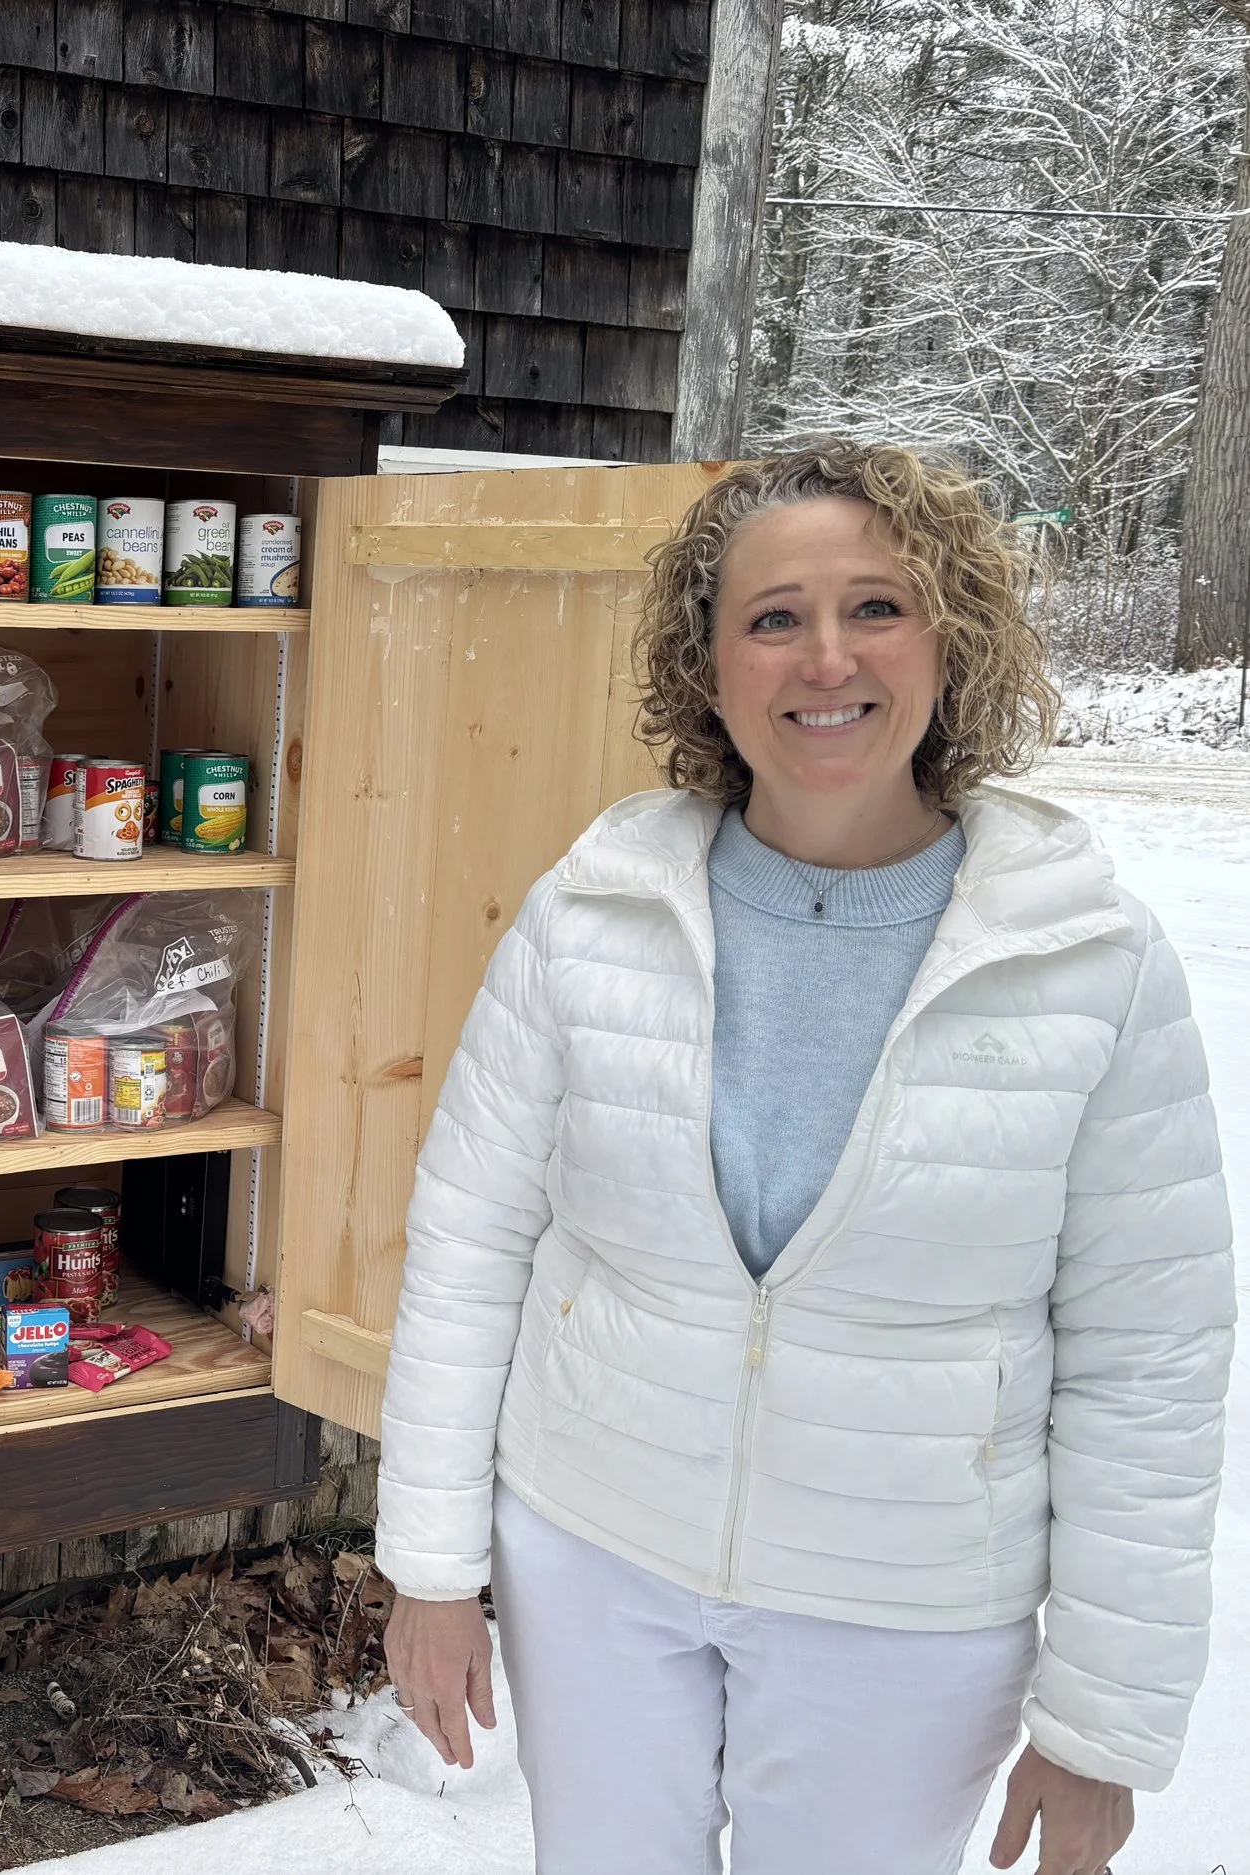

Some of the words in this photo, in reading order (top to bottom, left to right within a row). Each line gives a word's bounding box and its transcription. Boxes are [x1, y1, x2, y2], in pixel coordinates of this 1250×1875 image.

[54, 503, 92, 513] CHESTNUT
[63, 533, 84, 542] PEAS
[107, 527, 159, 539] cannellini
[198, 528, 230, 540] green
[123, 540, 158, 552] beans
[209, 925, 238, 936] TRUSTED
[197, 966, 221, 982] Chili
[953, 1053, 995, 1064] PIONEER
[997, 1056, 1027, 1065] CAMP
[57, 1251, 101, 1270] Hunt's
[82, 1269, 98, 1277] SAUCE
